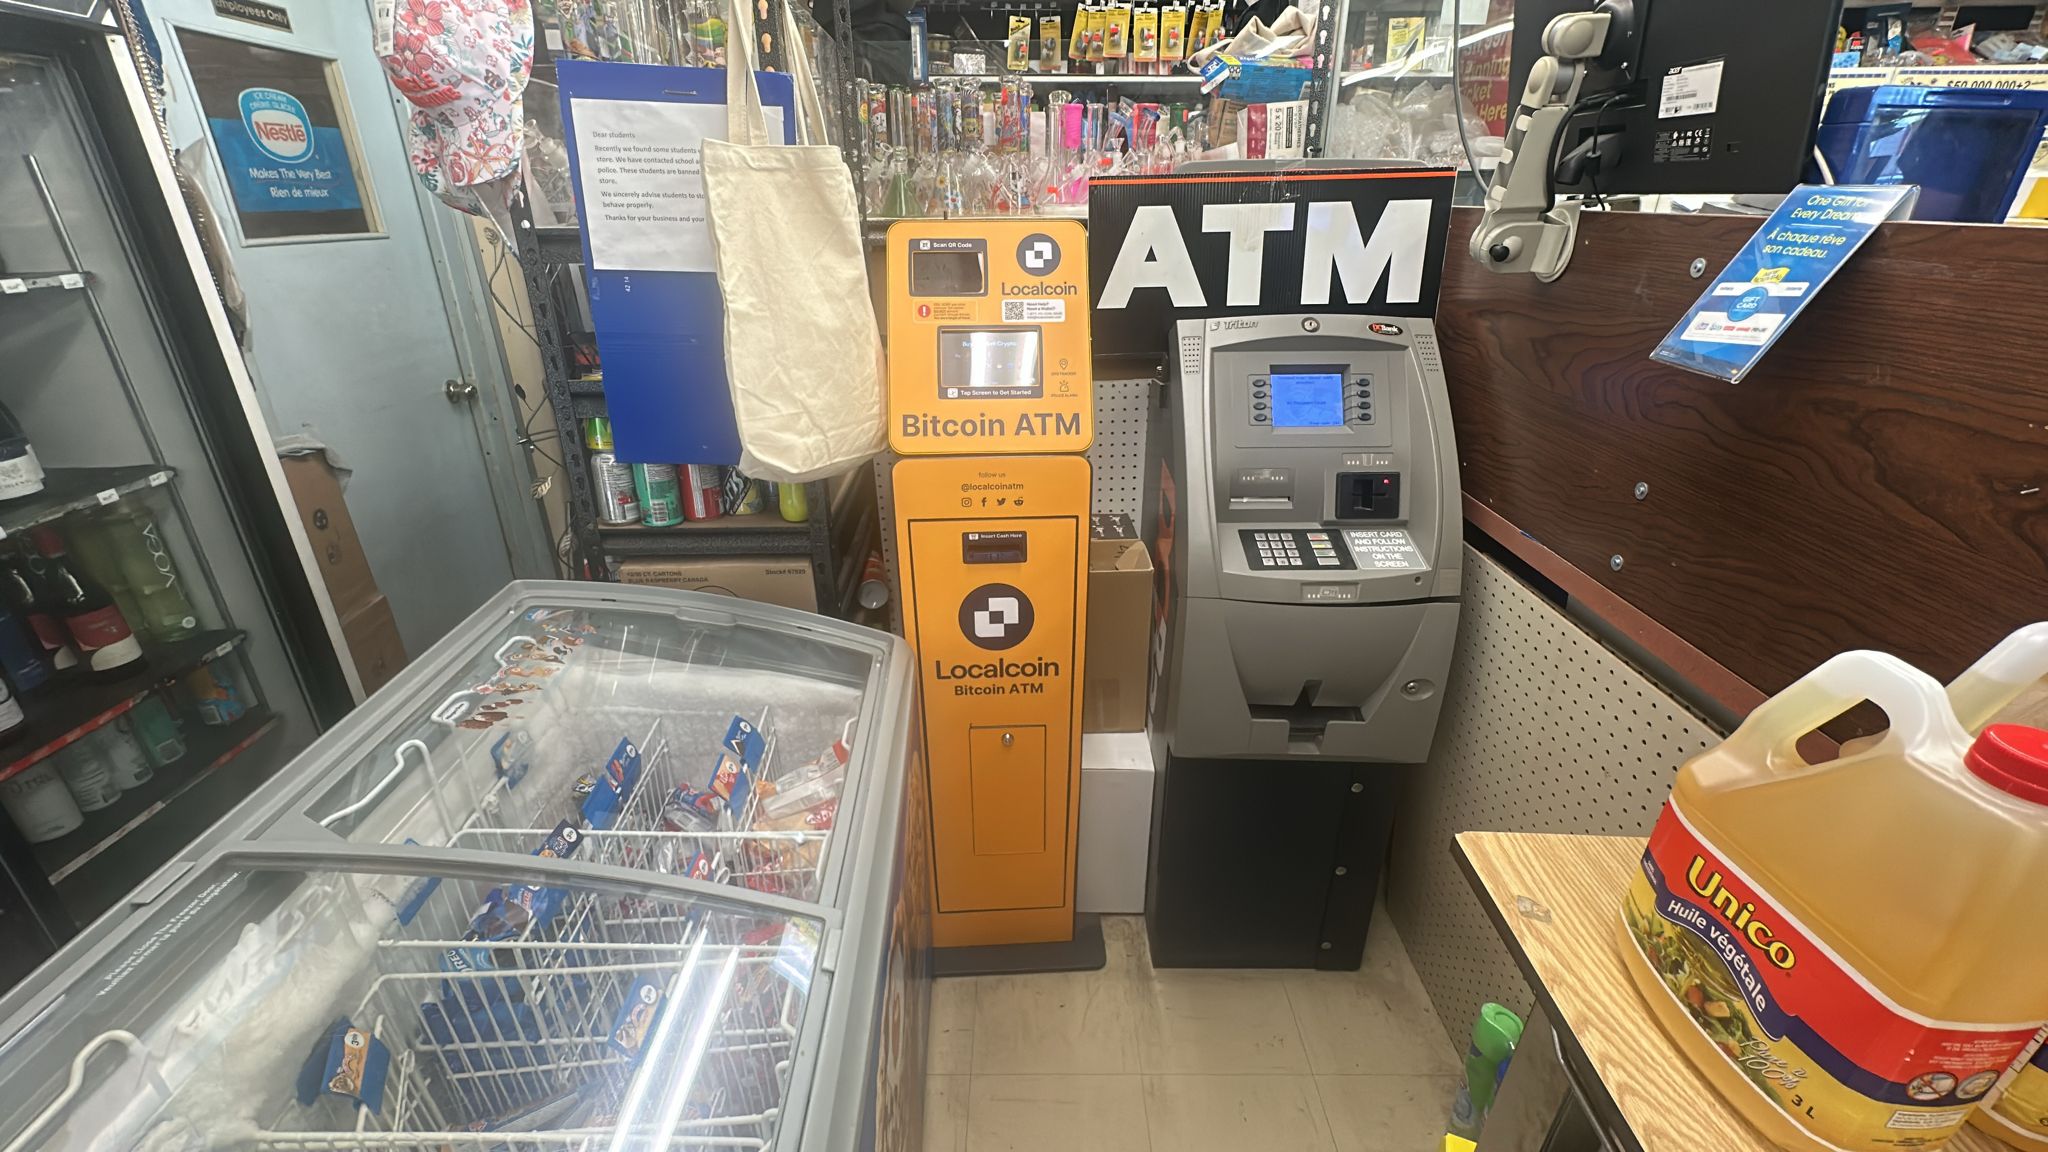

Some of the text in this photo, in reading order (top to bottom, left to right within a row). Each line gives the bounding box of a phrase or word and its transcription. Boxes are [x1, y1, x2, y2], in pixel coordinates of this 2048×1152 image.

[267, 10, 288, 24] Only
[254, 120, 307, 142] Nestlé
[1275, 122, 1282, 131] 20
[594, 145, 620, 153] Recently
[249, 168, 332, 180] Makes The Very Best
[270, 186, 329, 198] Rien de mieux
[1807, 194, 1831, 206] One
[1790, 208, 1822, 221] Every
[1767, 226, 1847, 246] À chaque rêve
[1096, 199, 1433, 309] ATM
[1762, 243, 1828, 258] son cadeau.
[1001, 281, 1078, 296] Localcoin
[1223, 321, 1259, 330] Triton
[902, 412, 1080, 438] Bitcoin ATM
[961, 482, 1024, 492] @localcoinatm
[935, 656, 1059, 680] Localcoin
[954, 683, 1044, 696] Bitcoin ATM
[1686, 854, 1796, 972] Unico
[1667, 898, 1768, 1014] Huile végétale
[1740, 1038, 1788, 1068] Pure
[1738, 1054, 1800, 1089] 100%
[1791, 1094, 1814, 1119] 3 L
